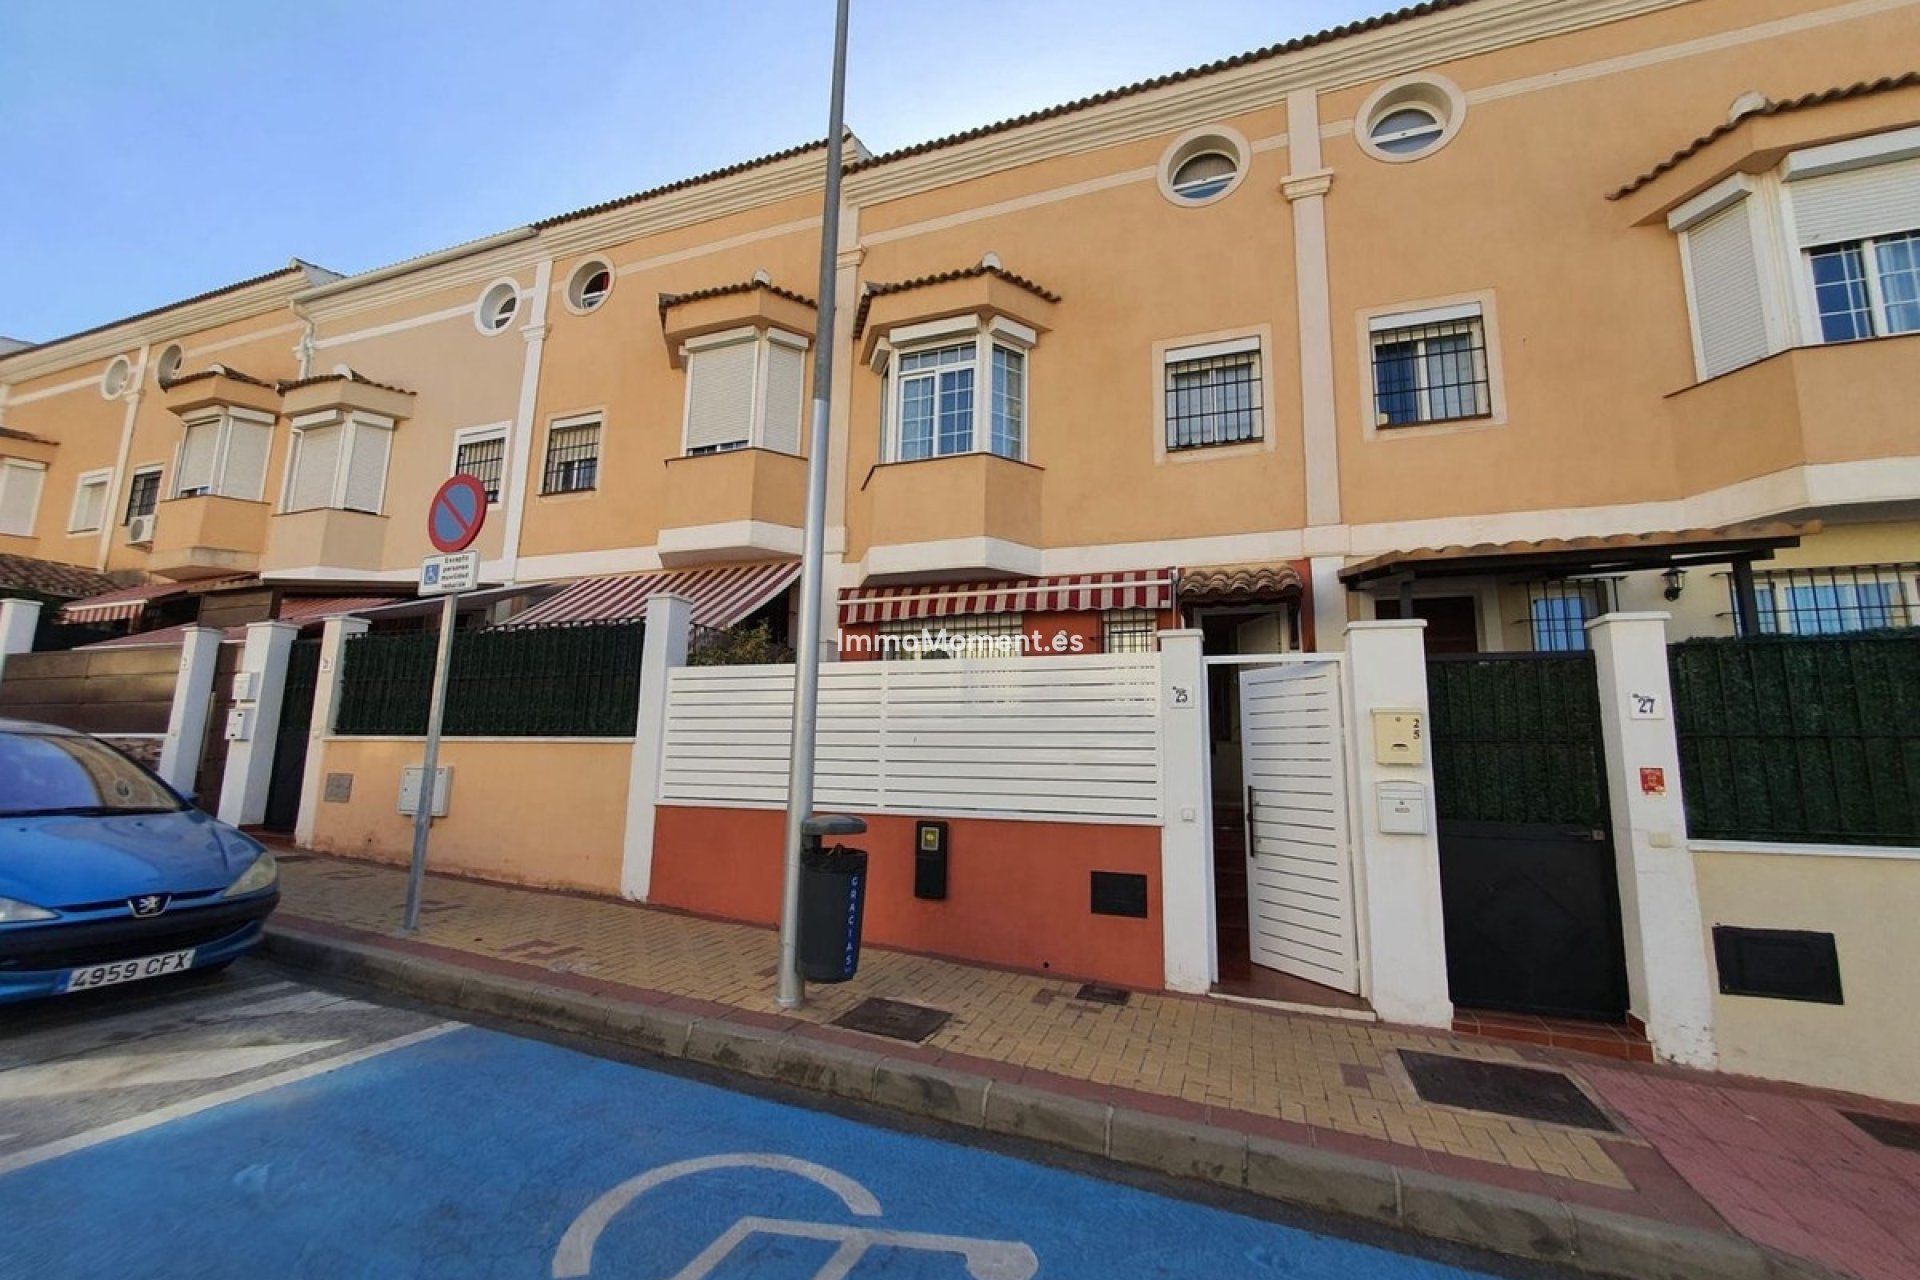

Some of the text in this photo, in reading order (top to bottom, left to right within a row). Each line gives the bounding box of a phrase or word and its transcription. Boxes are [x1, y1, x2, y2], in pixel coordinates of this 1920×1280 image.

[1637, 696, 1656, 714] 27
[845, 875, 859, 966] GRACIAS
[72, 951, 189, 987] 4959 CFX
